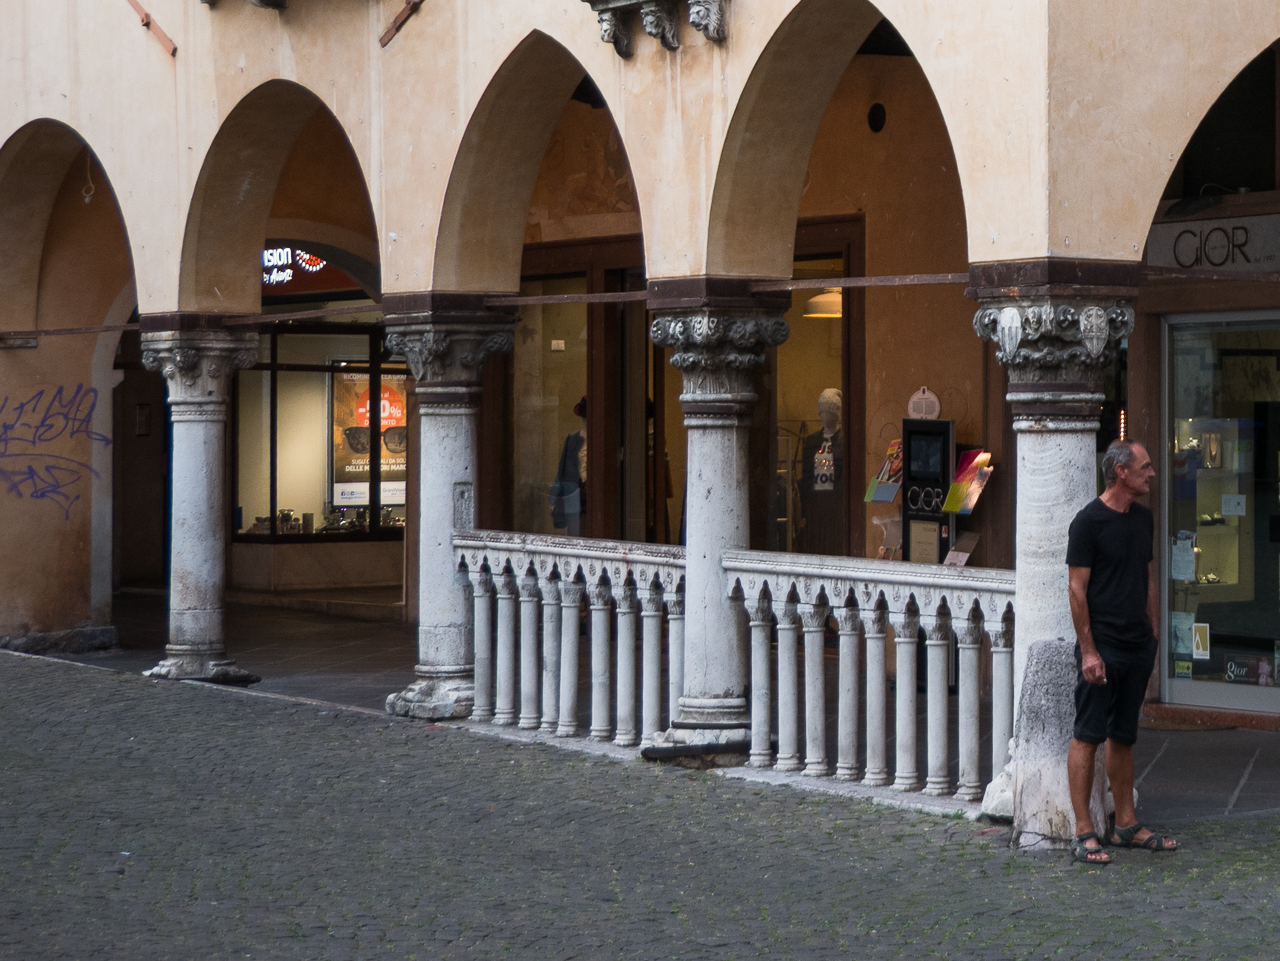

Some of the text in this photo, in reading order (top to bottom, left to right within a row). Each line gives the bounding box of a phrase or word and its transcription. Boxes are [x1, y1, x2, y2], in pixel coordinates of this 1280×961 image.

[1173, 226, 1251, 268] GIOR
[345, 464, 364, 472] DELLE
[907, 485, 944, 511] GIOR
[1225, 661, 1248, 682] gior
